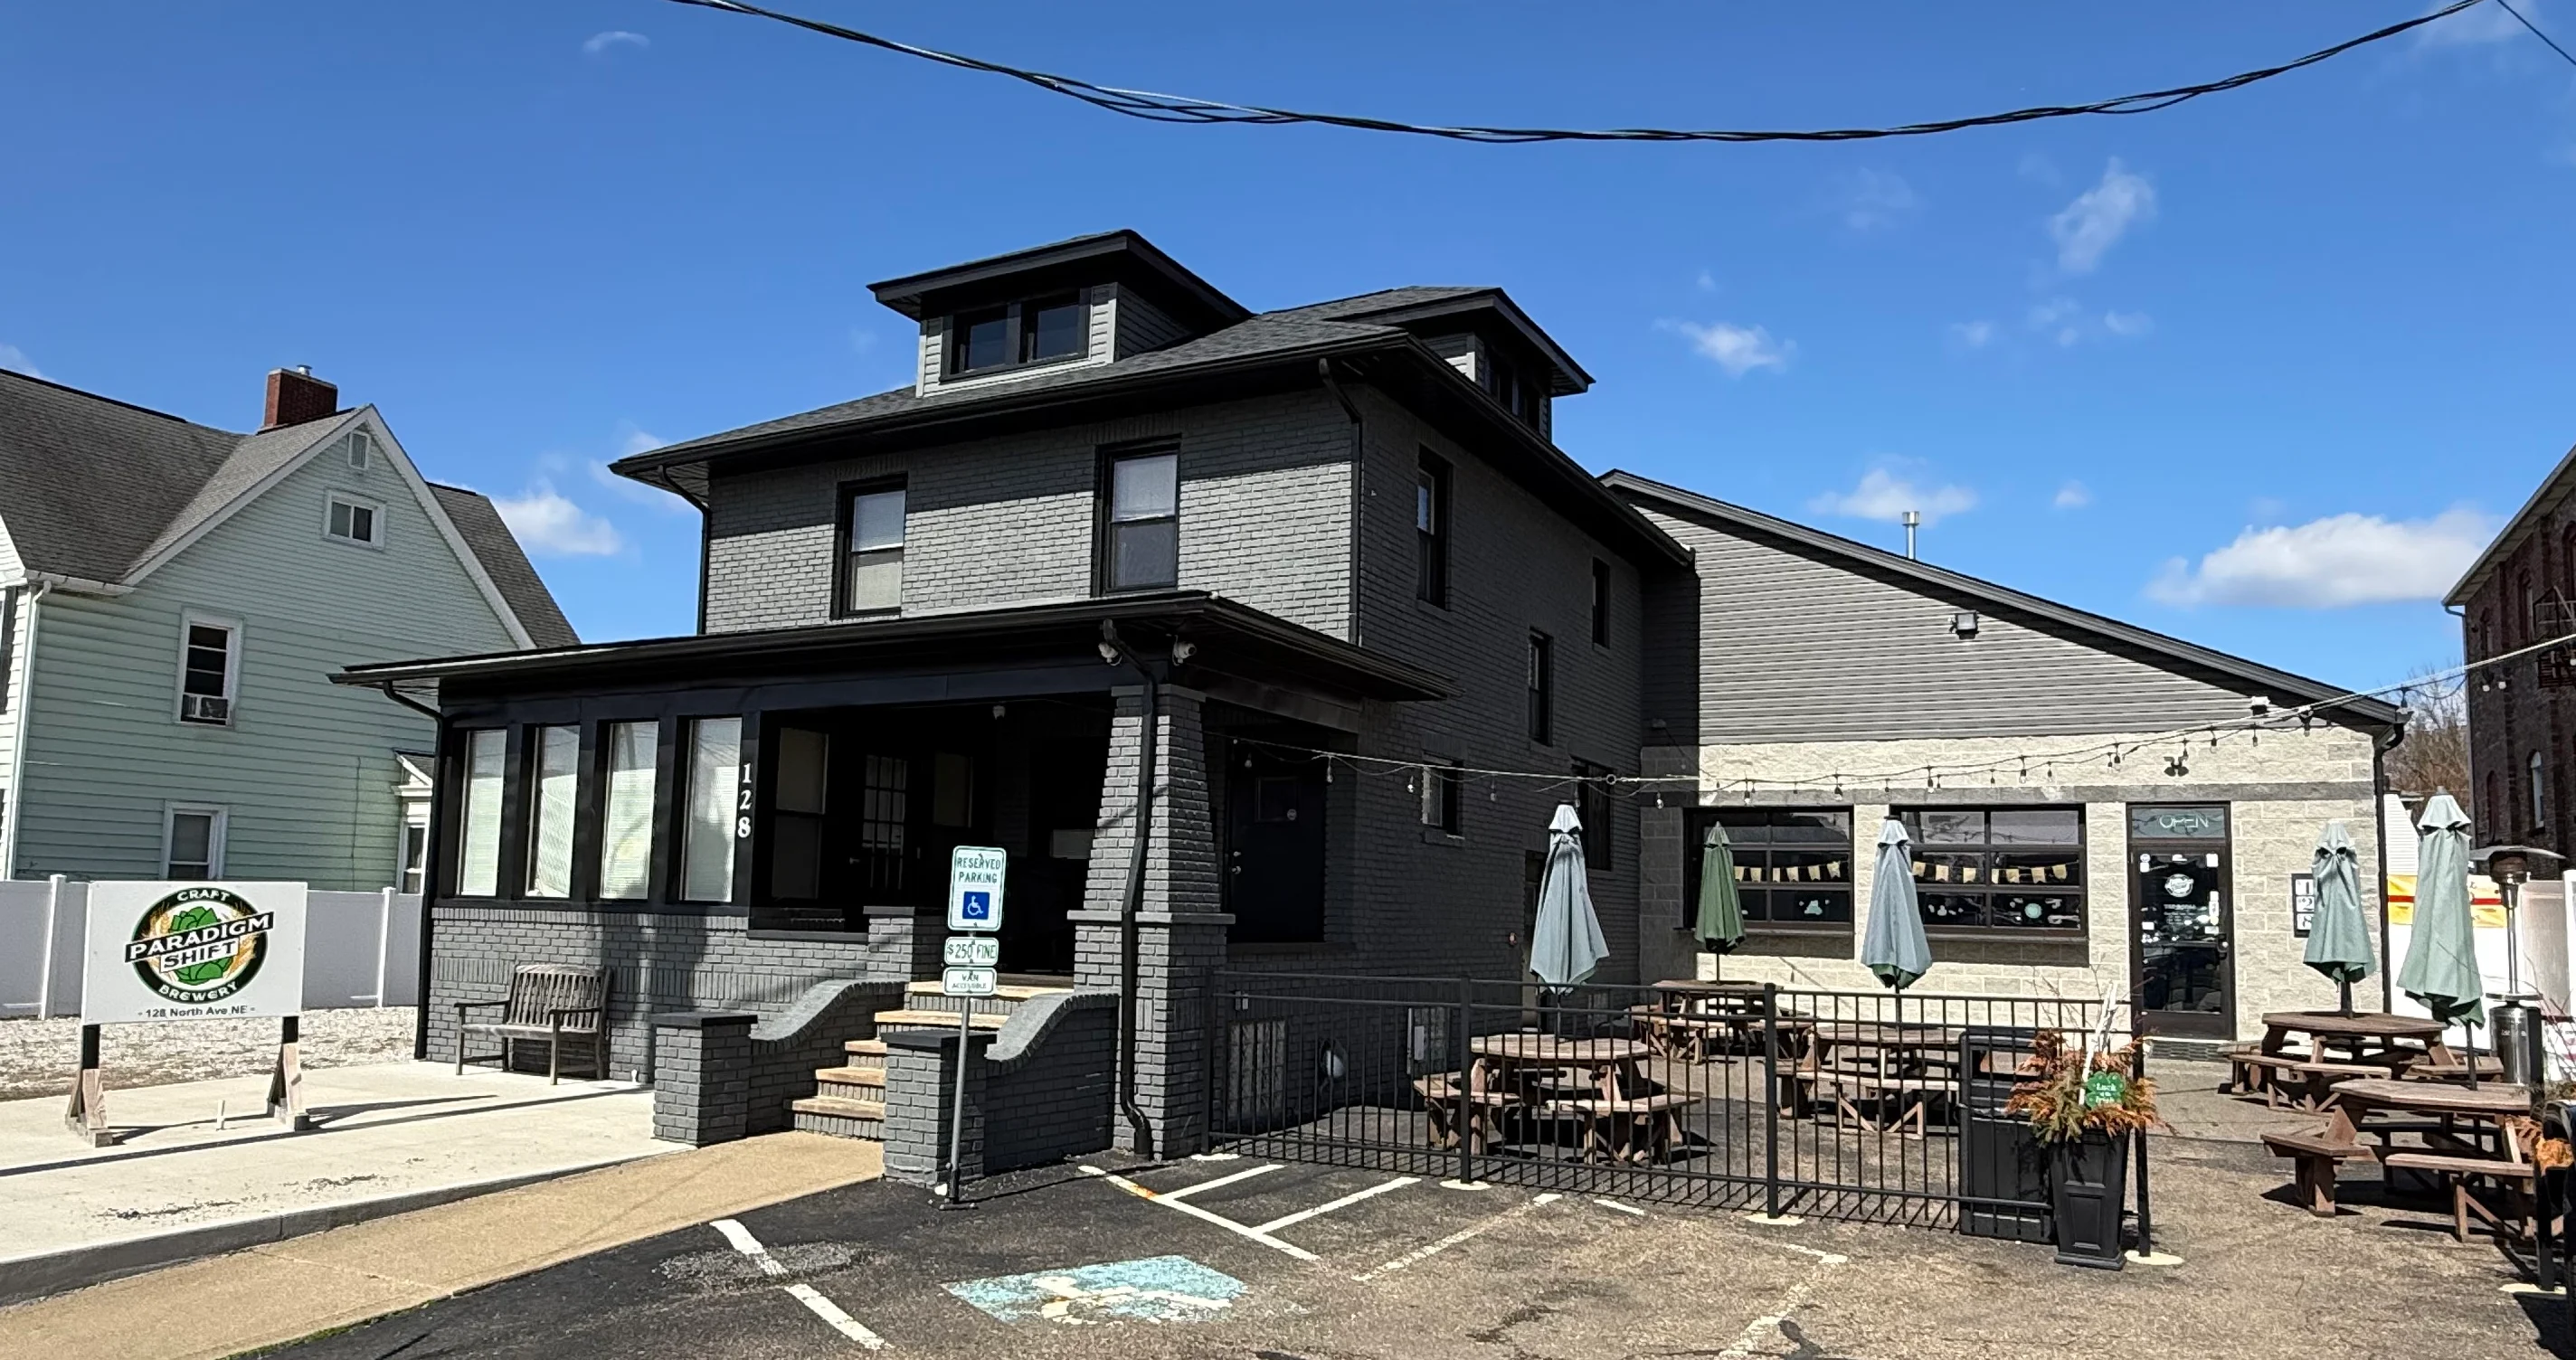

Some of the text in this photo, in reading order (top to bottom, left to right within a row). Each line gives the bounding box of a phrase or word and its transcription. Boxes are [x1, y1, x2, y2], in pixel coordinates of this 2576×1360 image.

[737, 762, 753, 838] 128
[2159, 814, 2209, 828] OPEN
[957, 857, 1001, 870] RESERVED
[959, 872, 998, 883] PARKING
[176, 889, 231, 902] CRAFT
[129, 914, 270, 959] PARADIGM
[164, 940, 236, 968] SHIFT
[977, 944, 996, 959] FINE
[961, 974, 979, 982] VAN
[158, 981, 238, 1002] BREWERY
[146, 1005, 248, 1018] 128 North Ave NE
